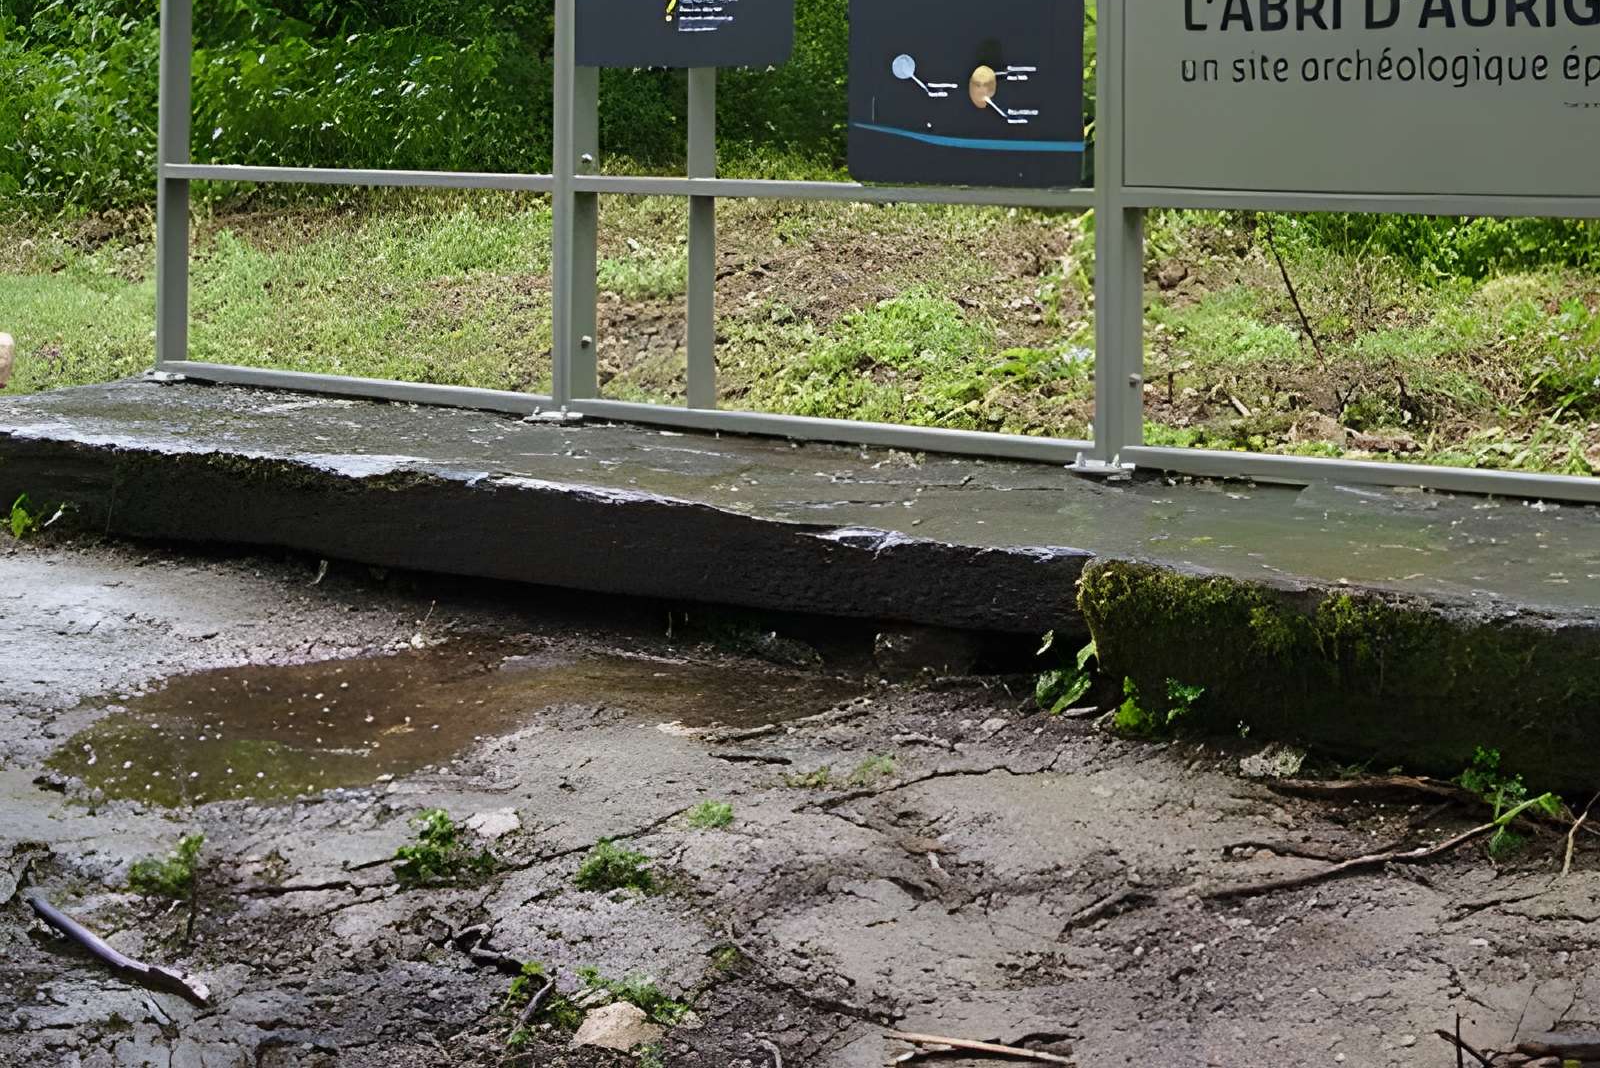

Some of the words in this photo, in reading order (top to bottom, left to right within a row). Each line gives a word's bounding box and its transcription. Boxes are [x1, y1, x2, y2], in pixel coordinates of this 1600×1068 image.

[1181, 59, 1219, 83] un
[1231, 49, 1289, 83] site
[1301, 46, 1549, 88] archéologique
